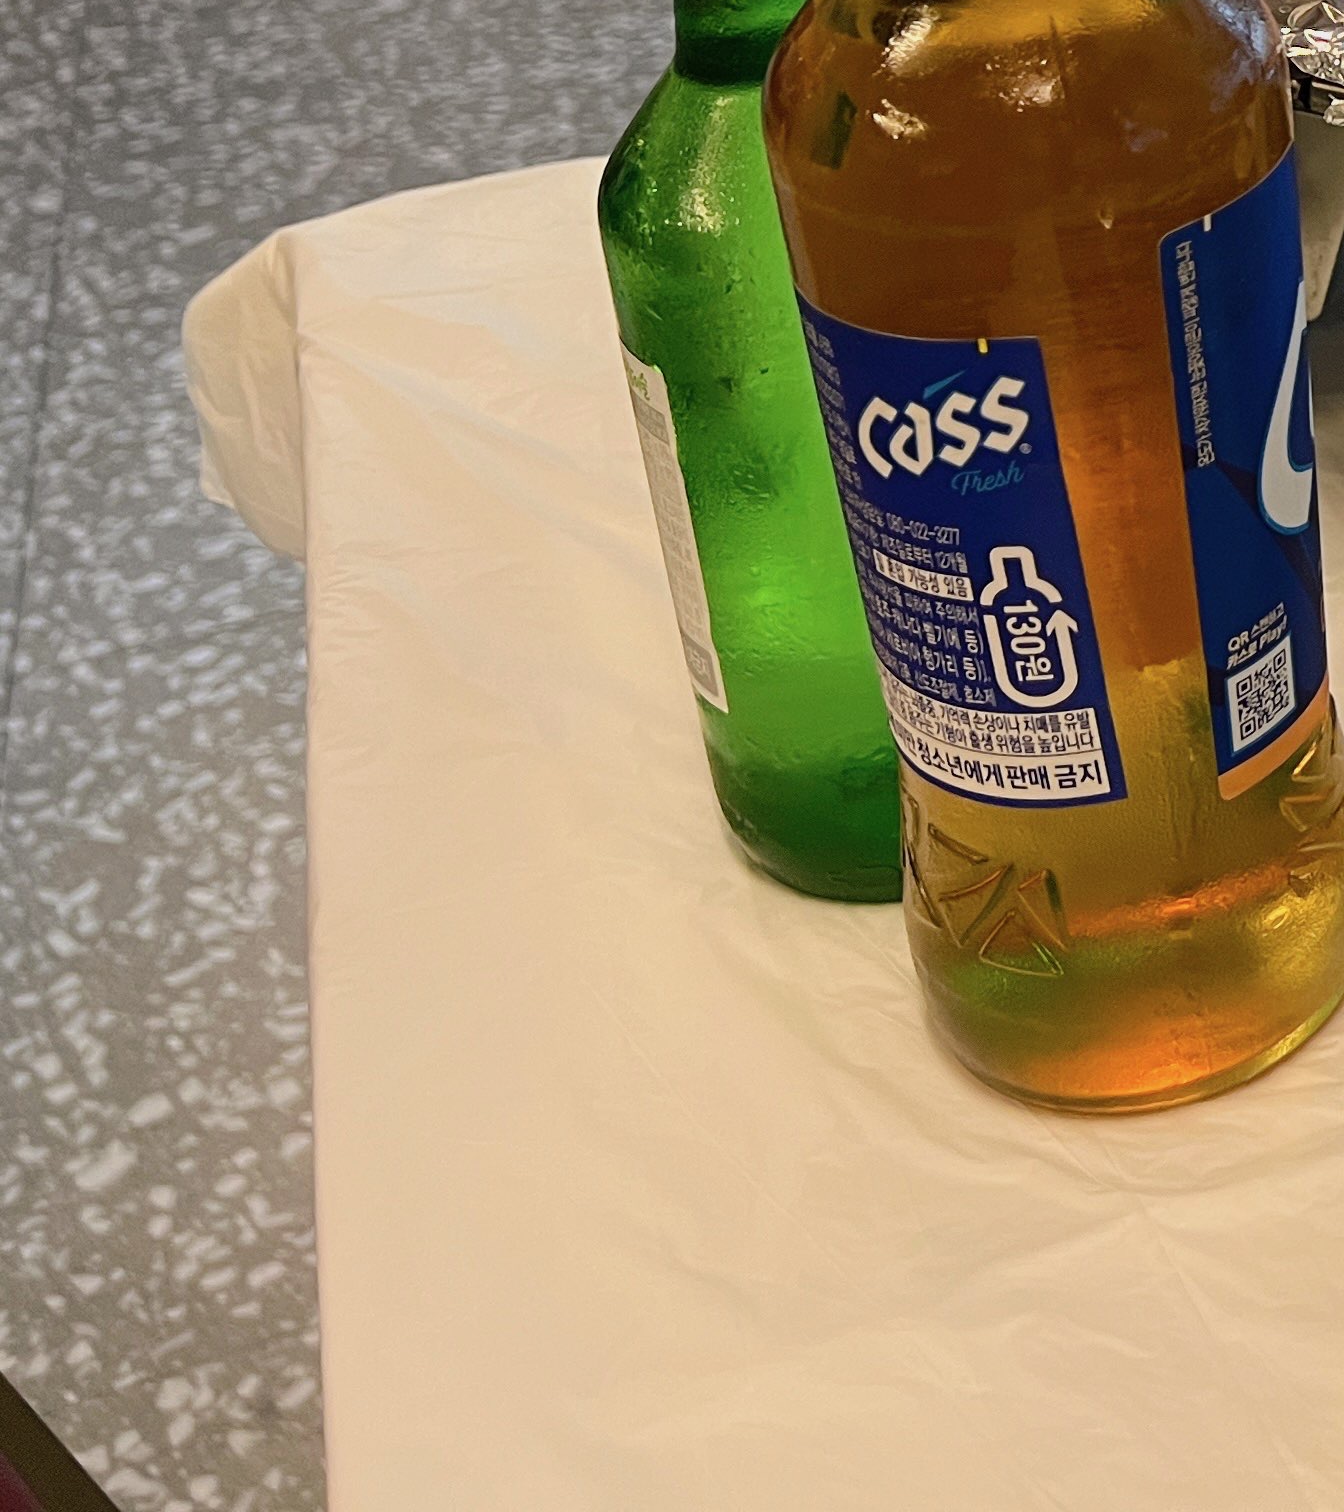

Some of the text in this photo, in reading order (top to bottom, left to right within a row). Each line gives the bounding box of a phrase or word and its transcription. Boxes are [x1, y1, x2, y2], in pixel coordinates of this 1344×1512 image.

[951, 460, 1025, 496] Fresh
[909, 567, 940, 594] 가능성
[943, 577, 968, 598] 있음
[1003, 600, 1054, 681] 130원
[1227, 630, 1250, 652] QR
[940, 704, 973, 729] 기억력
[973, 711, 1020, 733] 손상이나
[1024, 714, 1061, 734] 치매를
[1064, 711, 1091, 731] 유발
[969, 729, 994, 752] 출생
[996, 734, 1035, 755] 위험을
[1037, 731, 1095, 754] 높입니다
[916, 736, 1005, 789] 청소년에게
[1006, 762, 1051, 790] 판매
[1054, 759, 1103, 790] 금지
